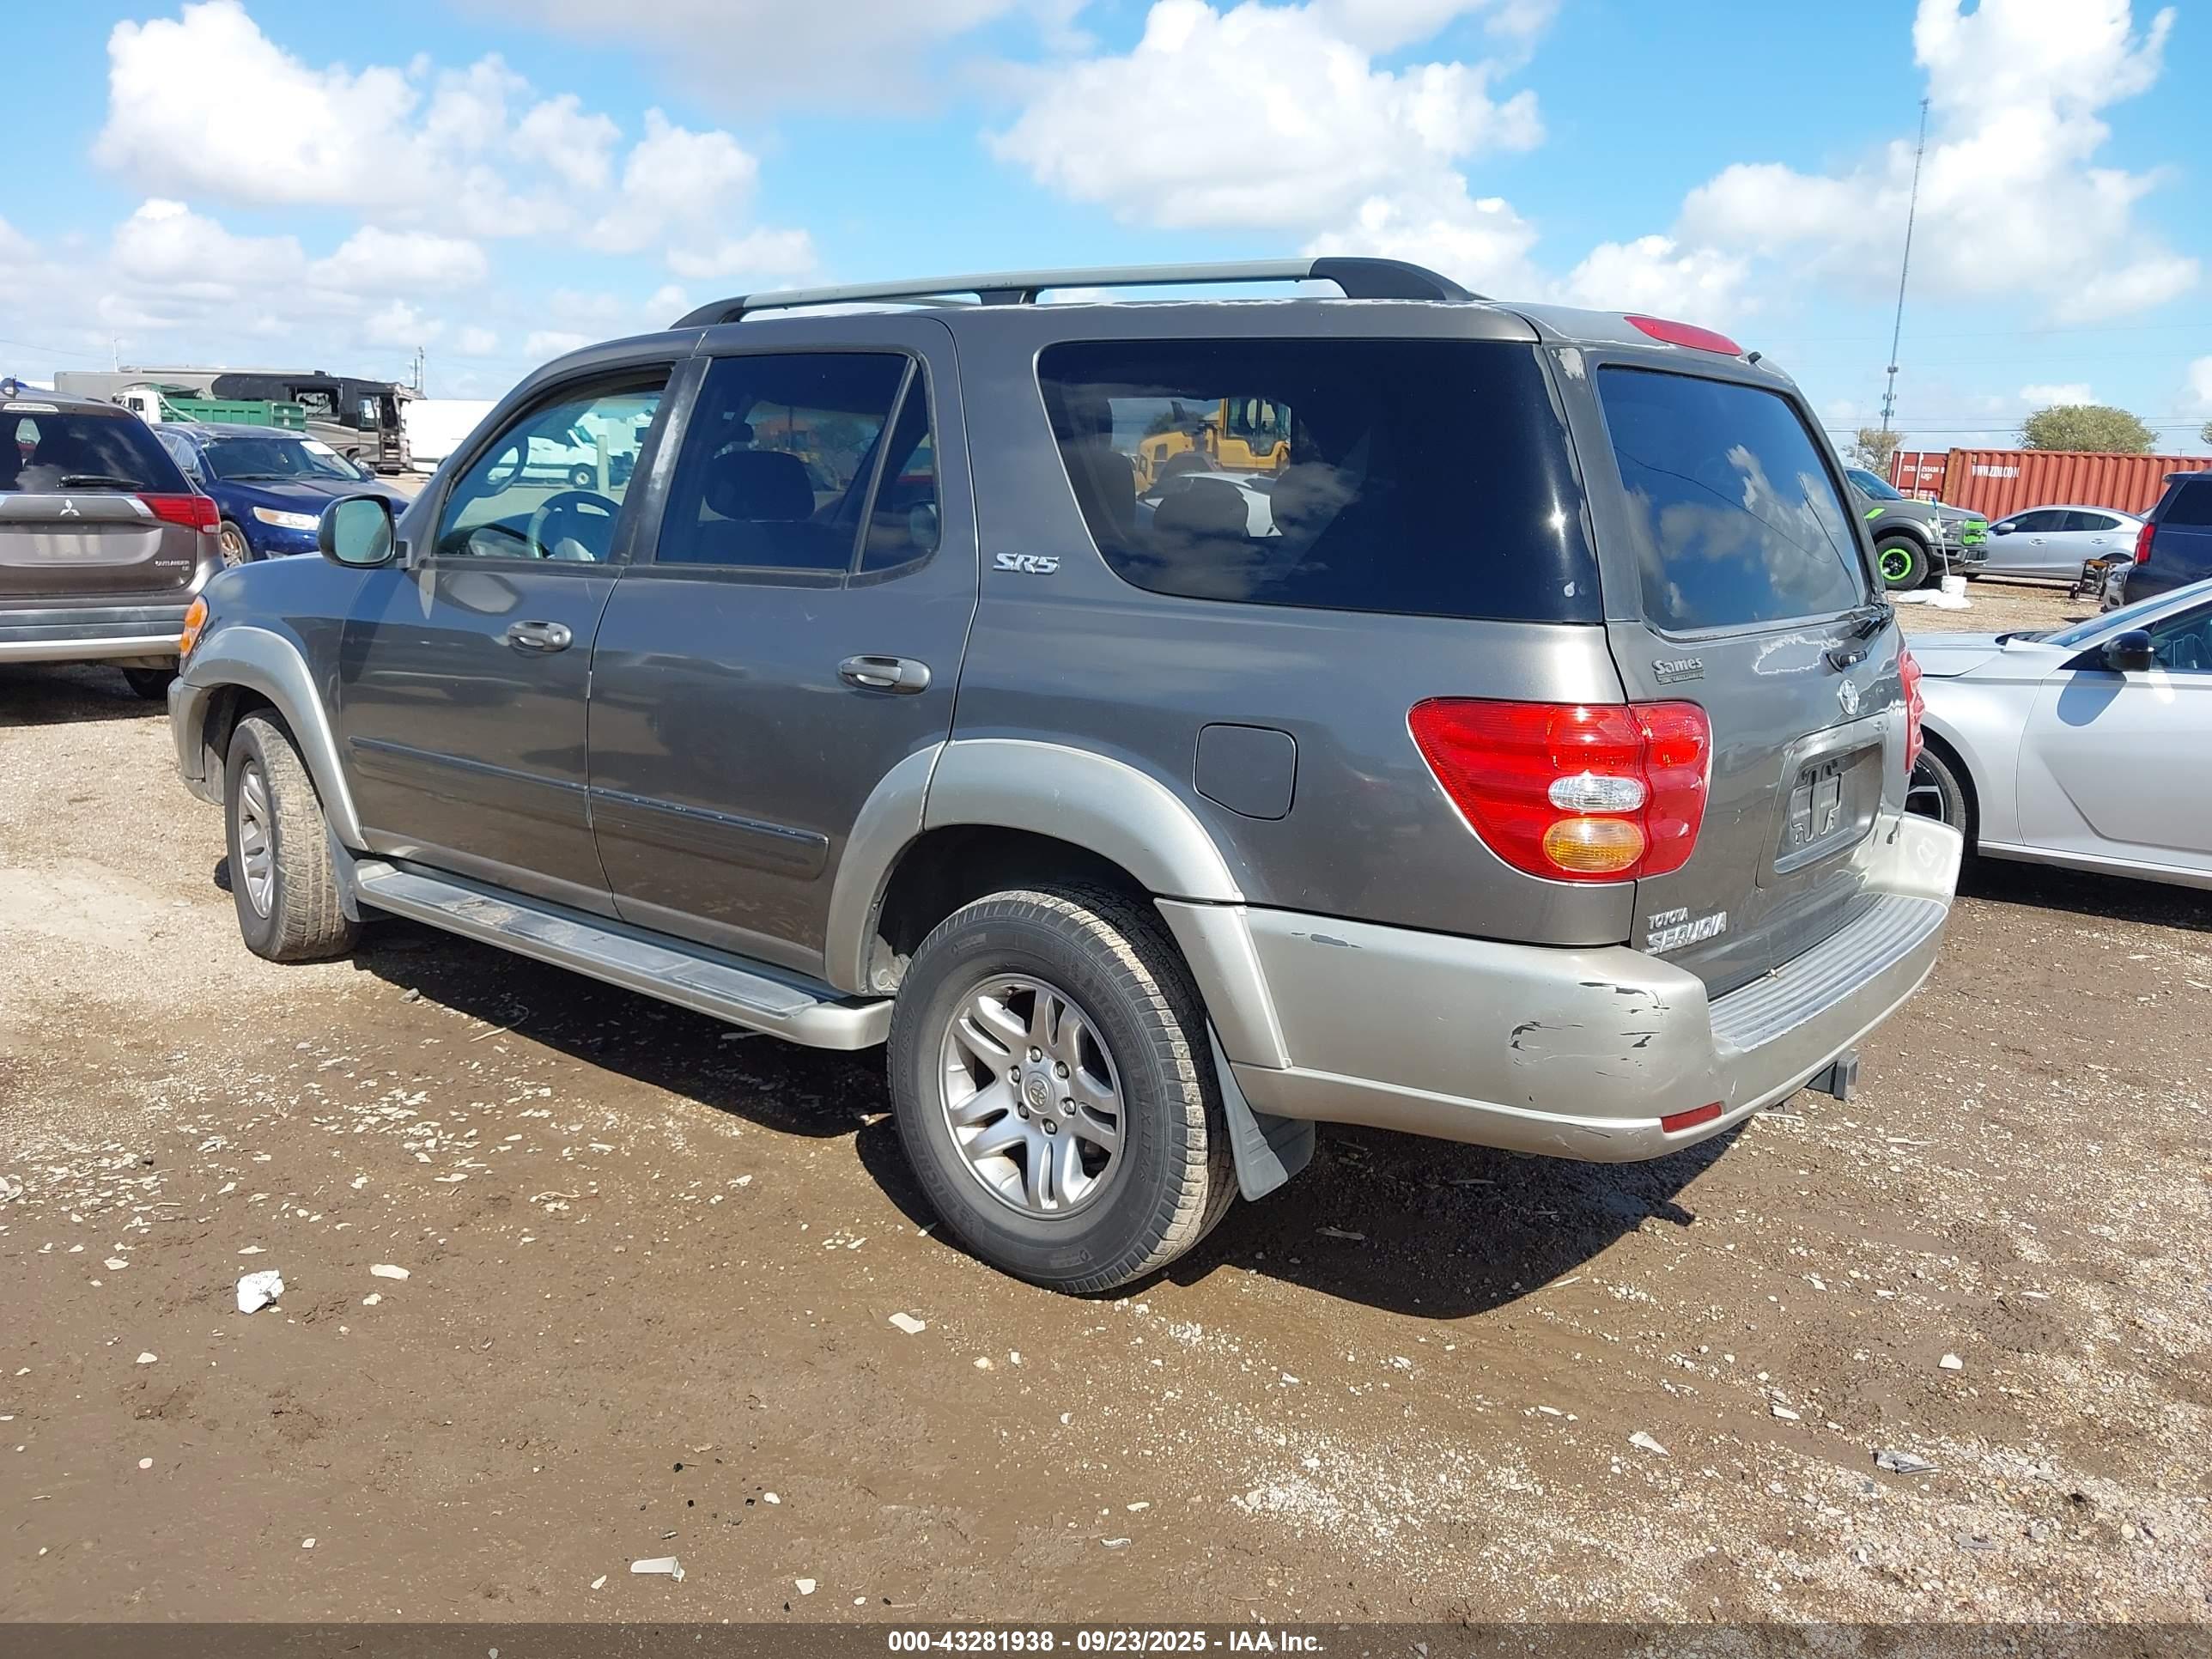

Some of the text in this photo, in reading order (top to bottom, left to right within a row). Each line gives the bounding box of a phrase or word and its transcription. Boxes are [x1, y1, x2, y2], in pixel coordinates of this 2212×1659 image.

[1653, 658, 1703, 675] Sames
[1646, 907, 1689, 931] TOYOTA
[1641, 910, 1728, 957] SEQUOIA
